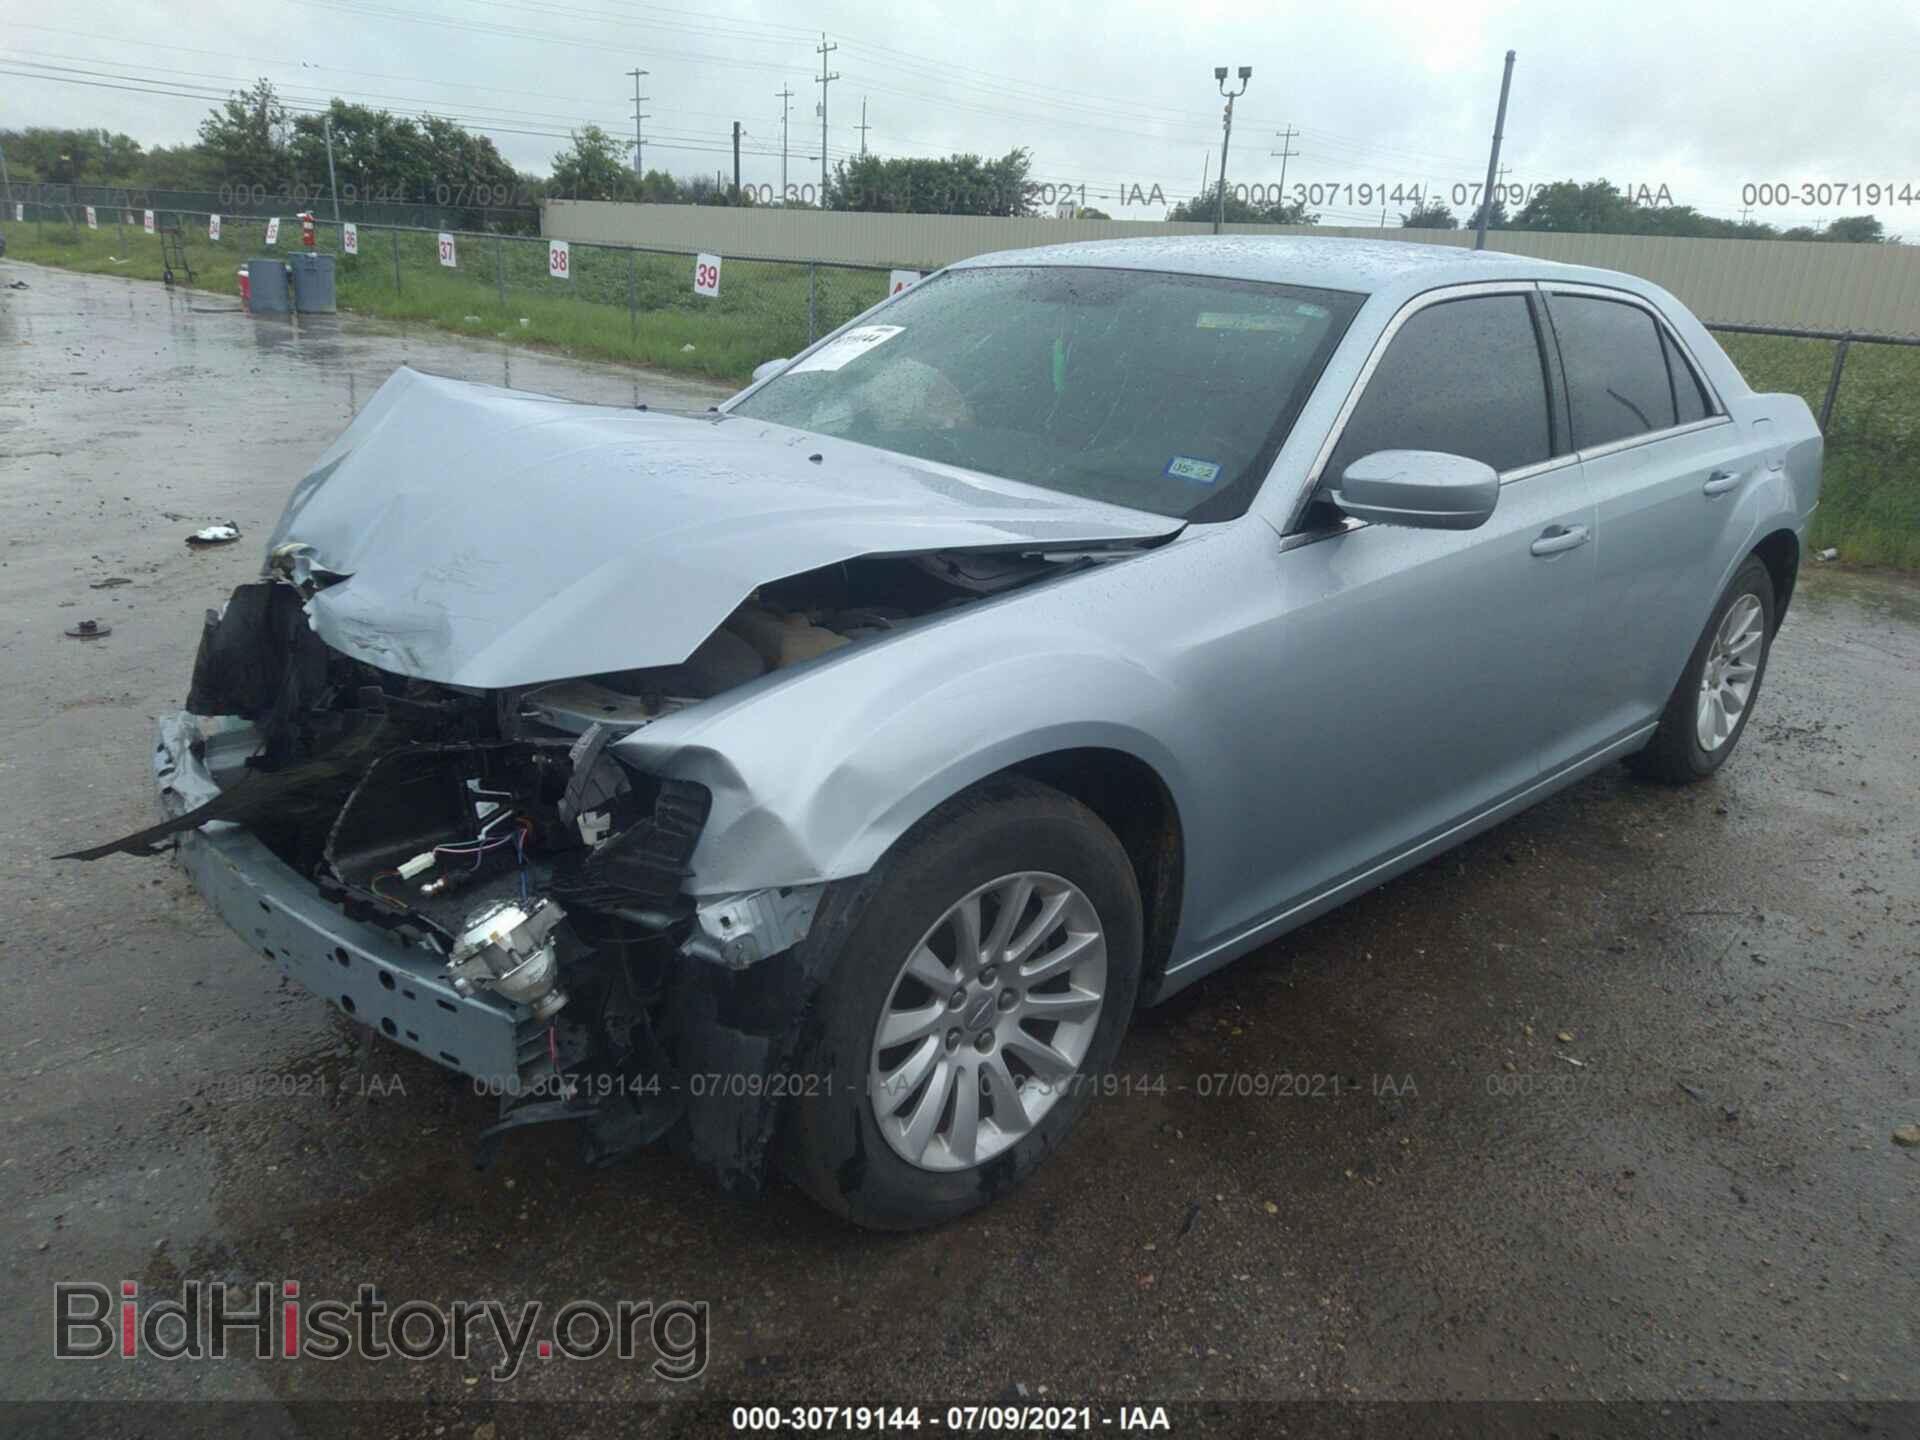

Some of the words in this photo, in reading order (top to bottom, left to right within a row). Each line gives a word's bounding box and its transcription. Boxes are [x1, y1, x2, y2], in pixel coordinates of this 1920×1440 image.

[440, 241, 453, 261] 37
[550, 249, 568, 272] 38
[696, 264, 718, 289] 39
